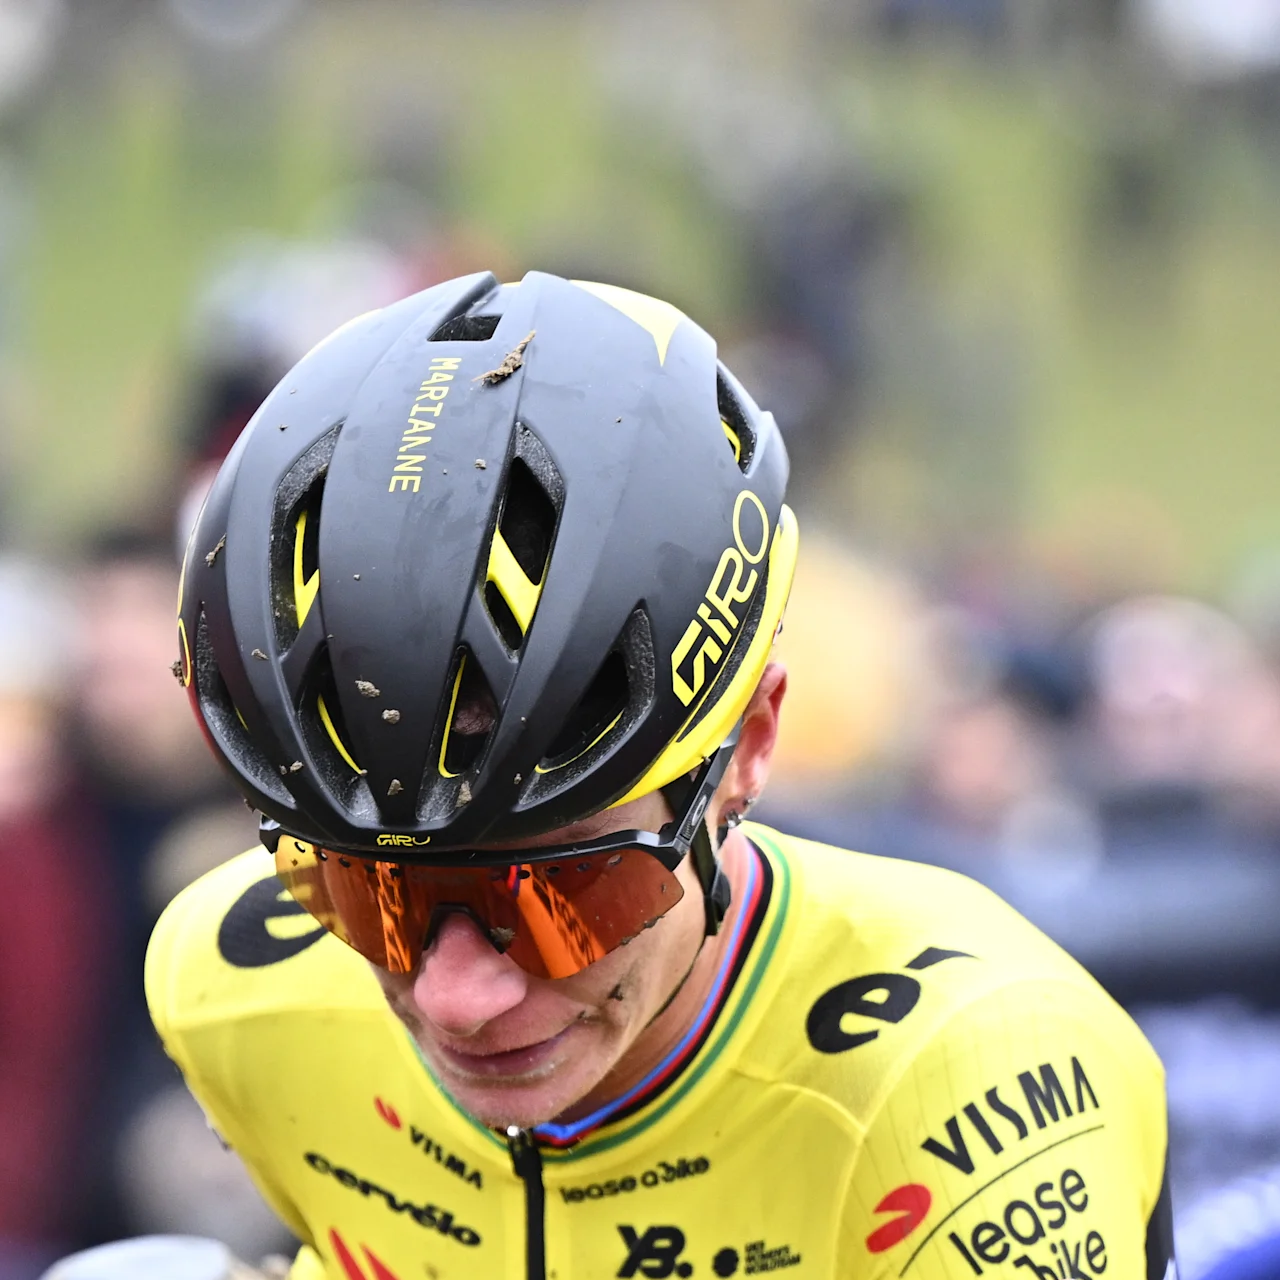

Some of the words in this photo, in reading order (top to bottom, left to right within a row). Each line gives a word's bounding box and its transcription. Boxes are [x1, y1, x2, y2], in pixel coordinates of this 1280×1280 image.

[388, 356, 461, 493] MARIANNE
[671, 489, 769, 707] GIRO
[409, 1124, 484, 1190] VISMA
[920, 1055, 1101, 1177] VISMA
[303, 1151, 482, 1248] cervélo
[559, 1175, 637, 1204] lease
[948, 1168, 1089, 1276] lease
